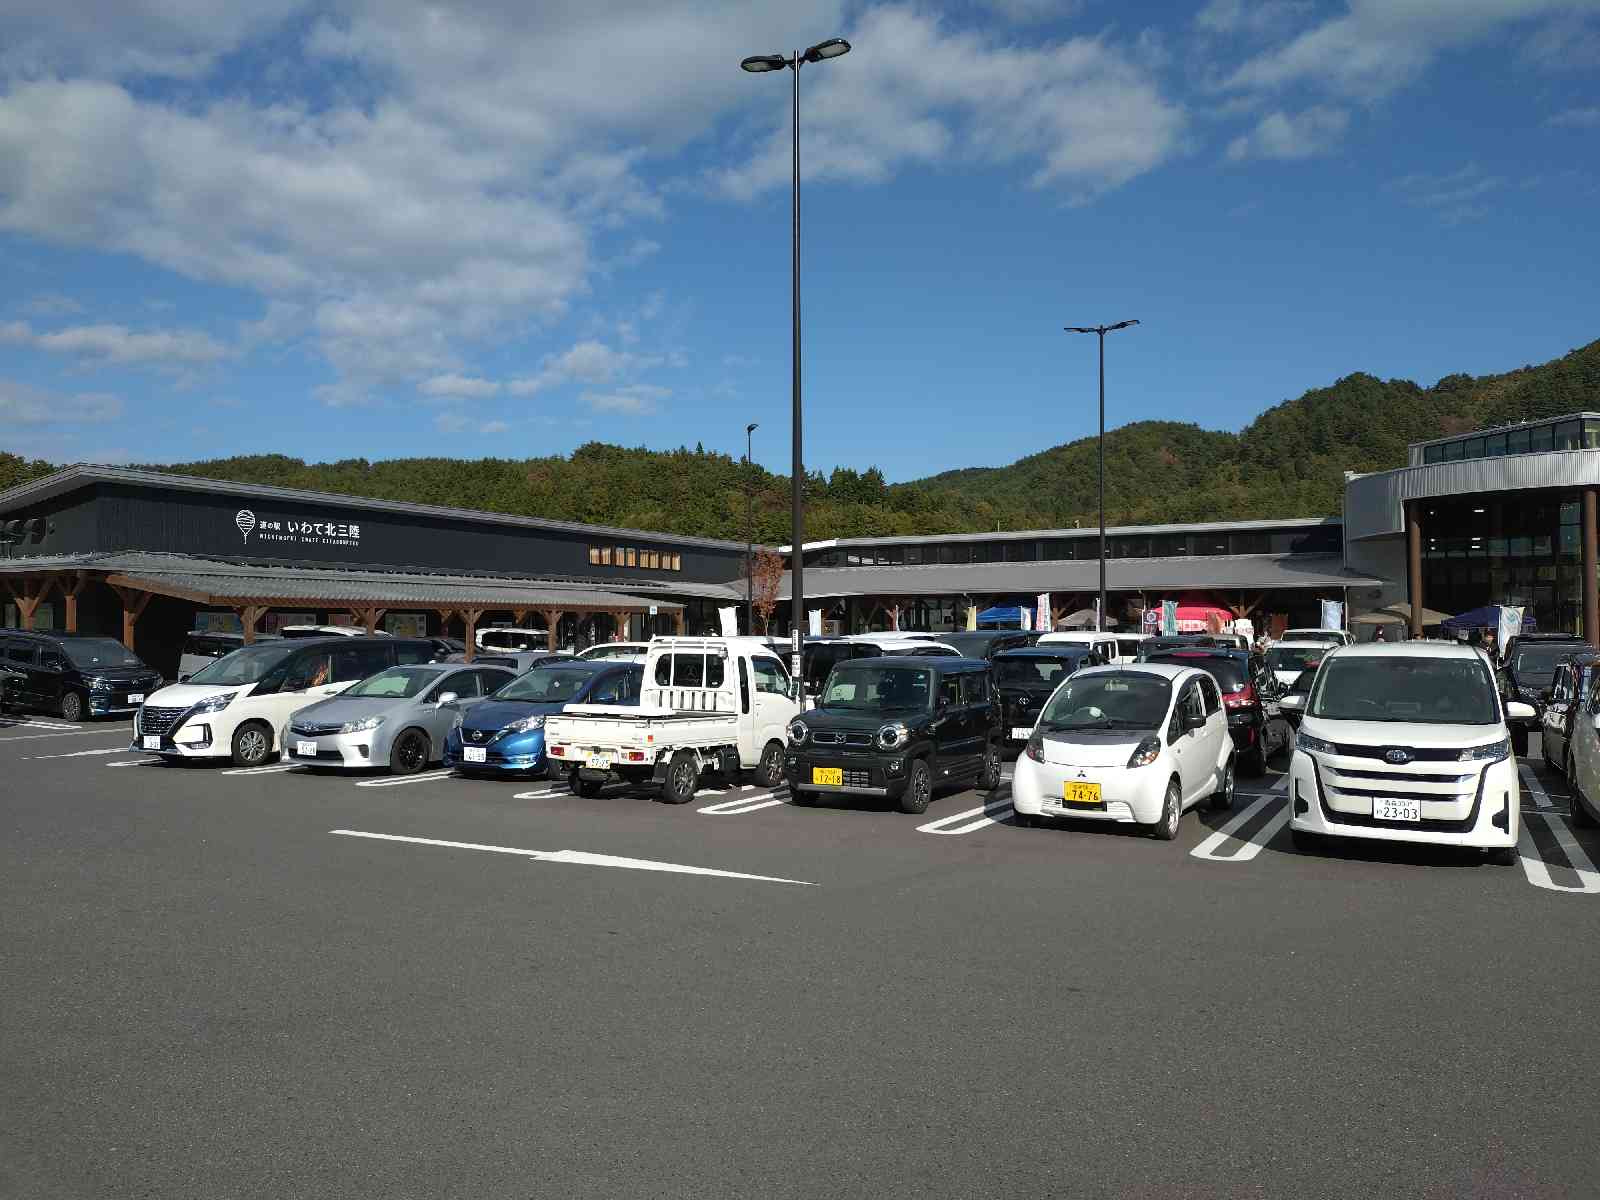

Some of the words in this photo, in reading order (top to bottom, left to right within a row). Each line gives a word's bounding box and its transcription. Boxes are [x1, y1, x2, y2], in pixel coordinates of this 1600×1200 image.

[259, 520, 281, 531] 道の駅
[287, 521, 360, 539] いわて北三陸
[1383, 806, 1418, 820] 23-03
